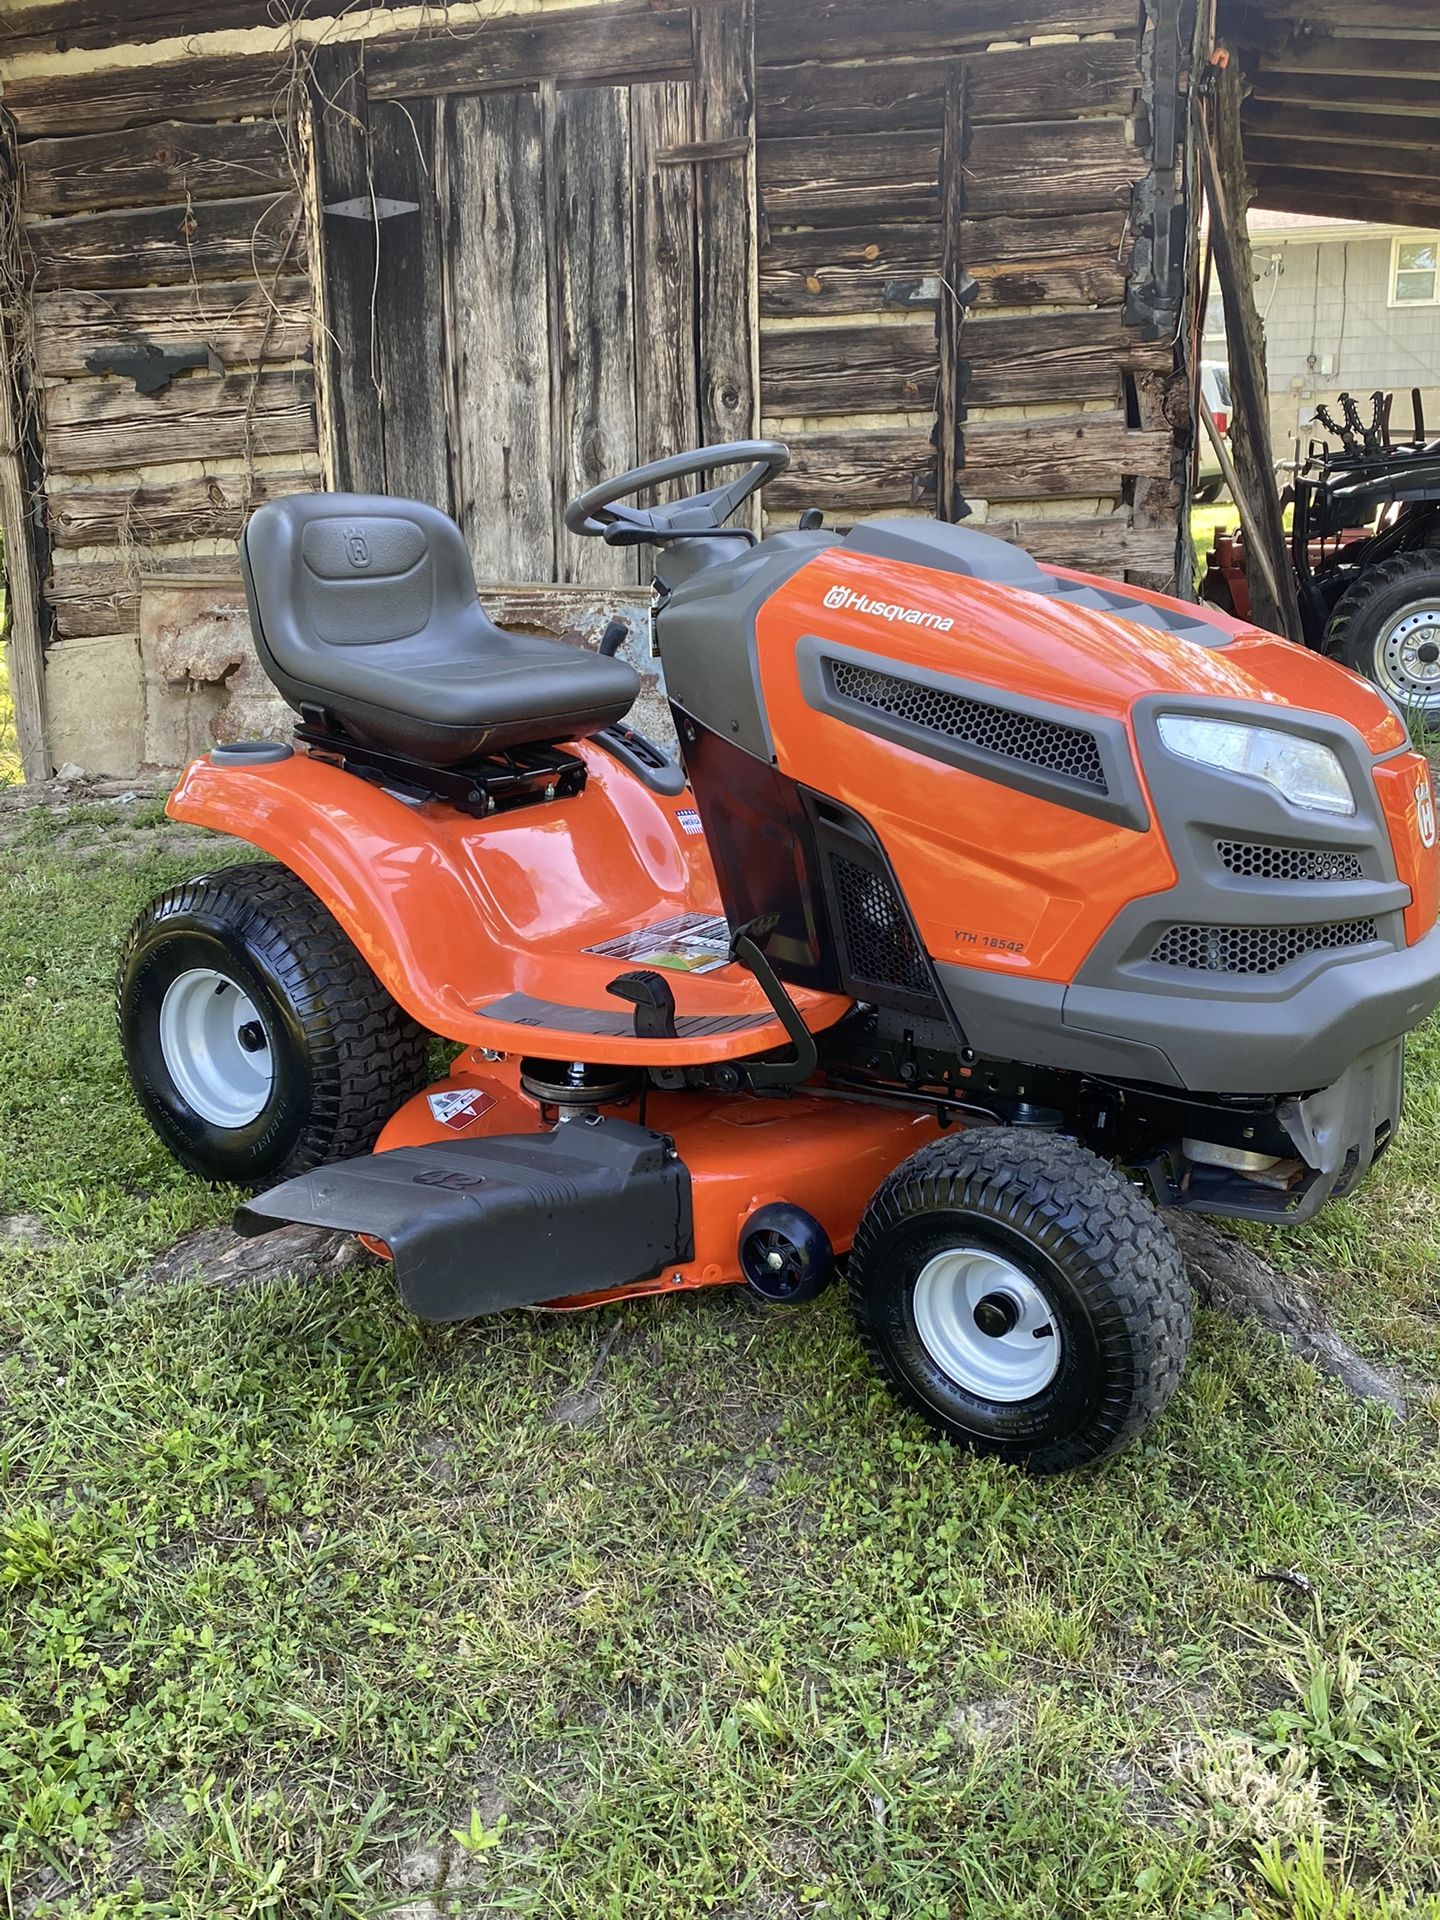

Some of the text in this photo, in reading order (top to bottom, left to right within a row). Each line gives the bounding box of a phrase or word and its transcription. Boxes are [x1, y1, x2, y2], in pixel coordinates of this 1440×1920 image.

[844, 592, 955, 632] Husqvarna
[954, 930, 1025, 953] YTH 18542
